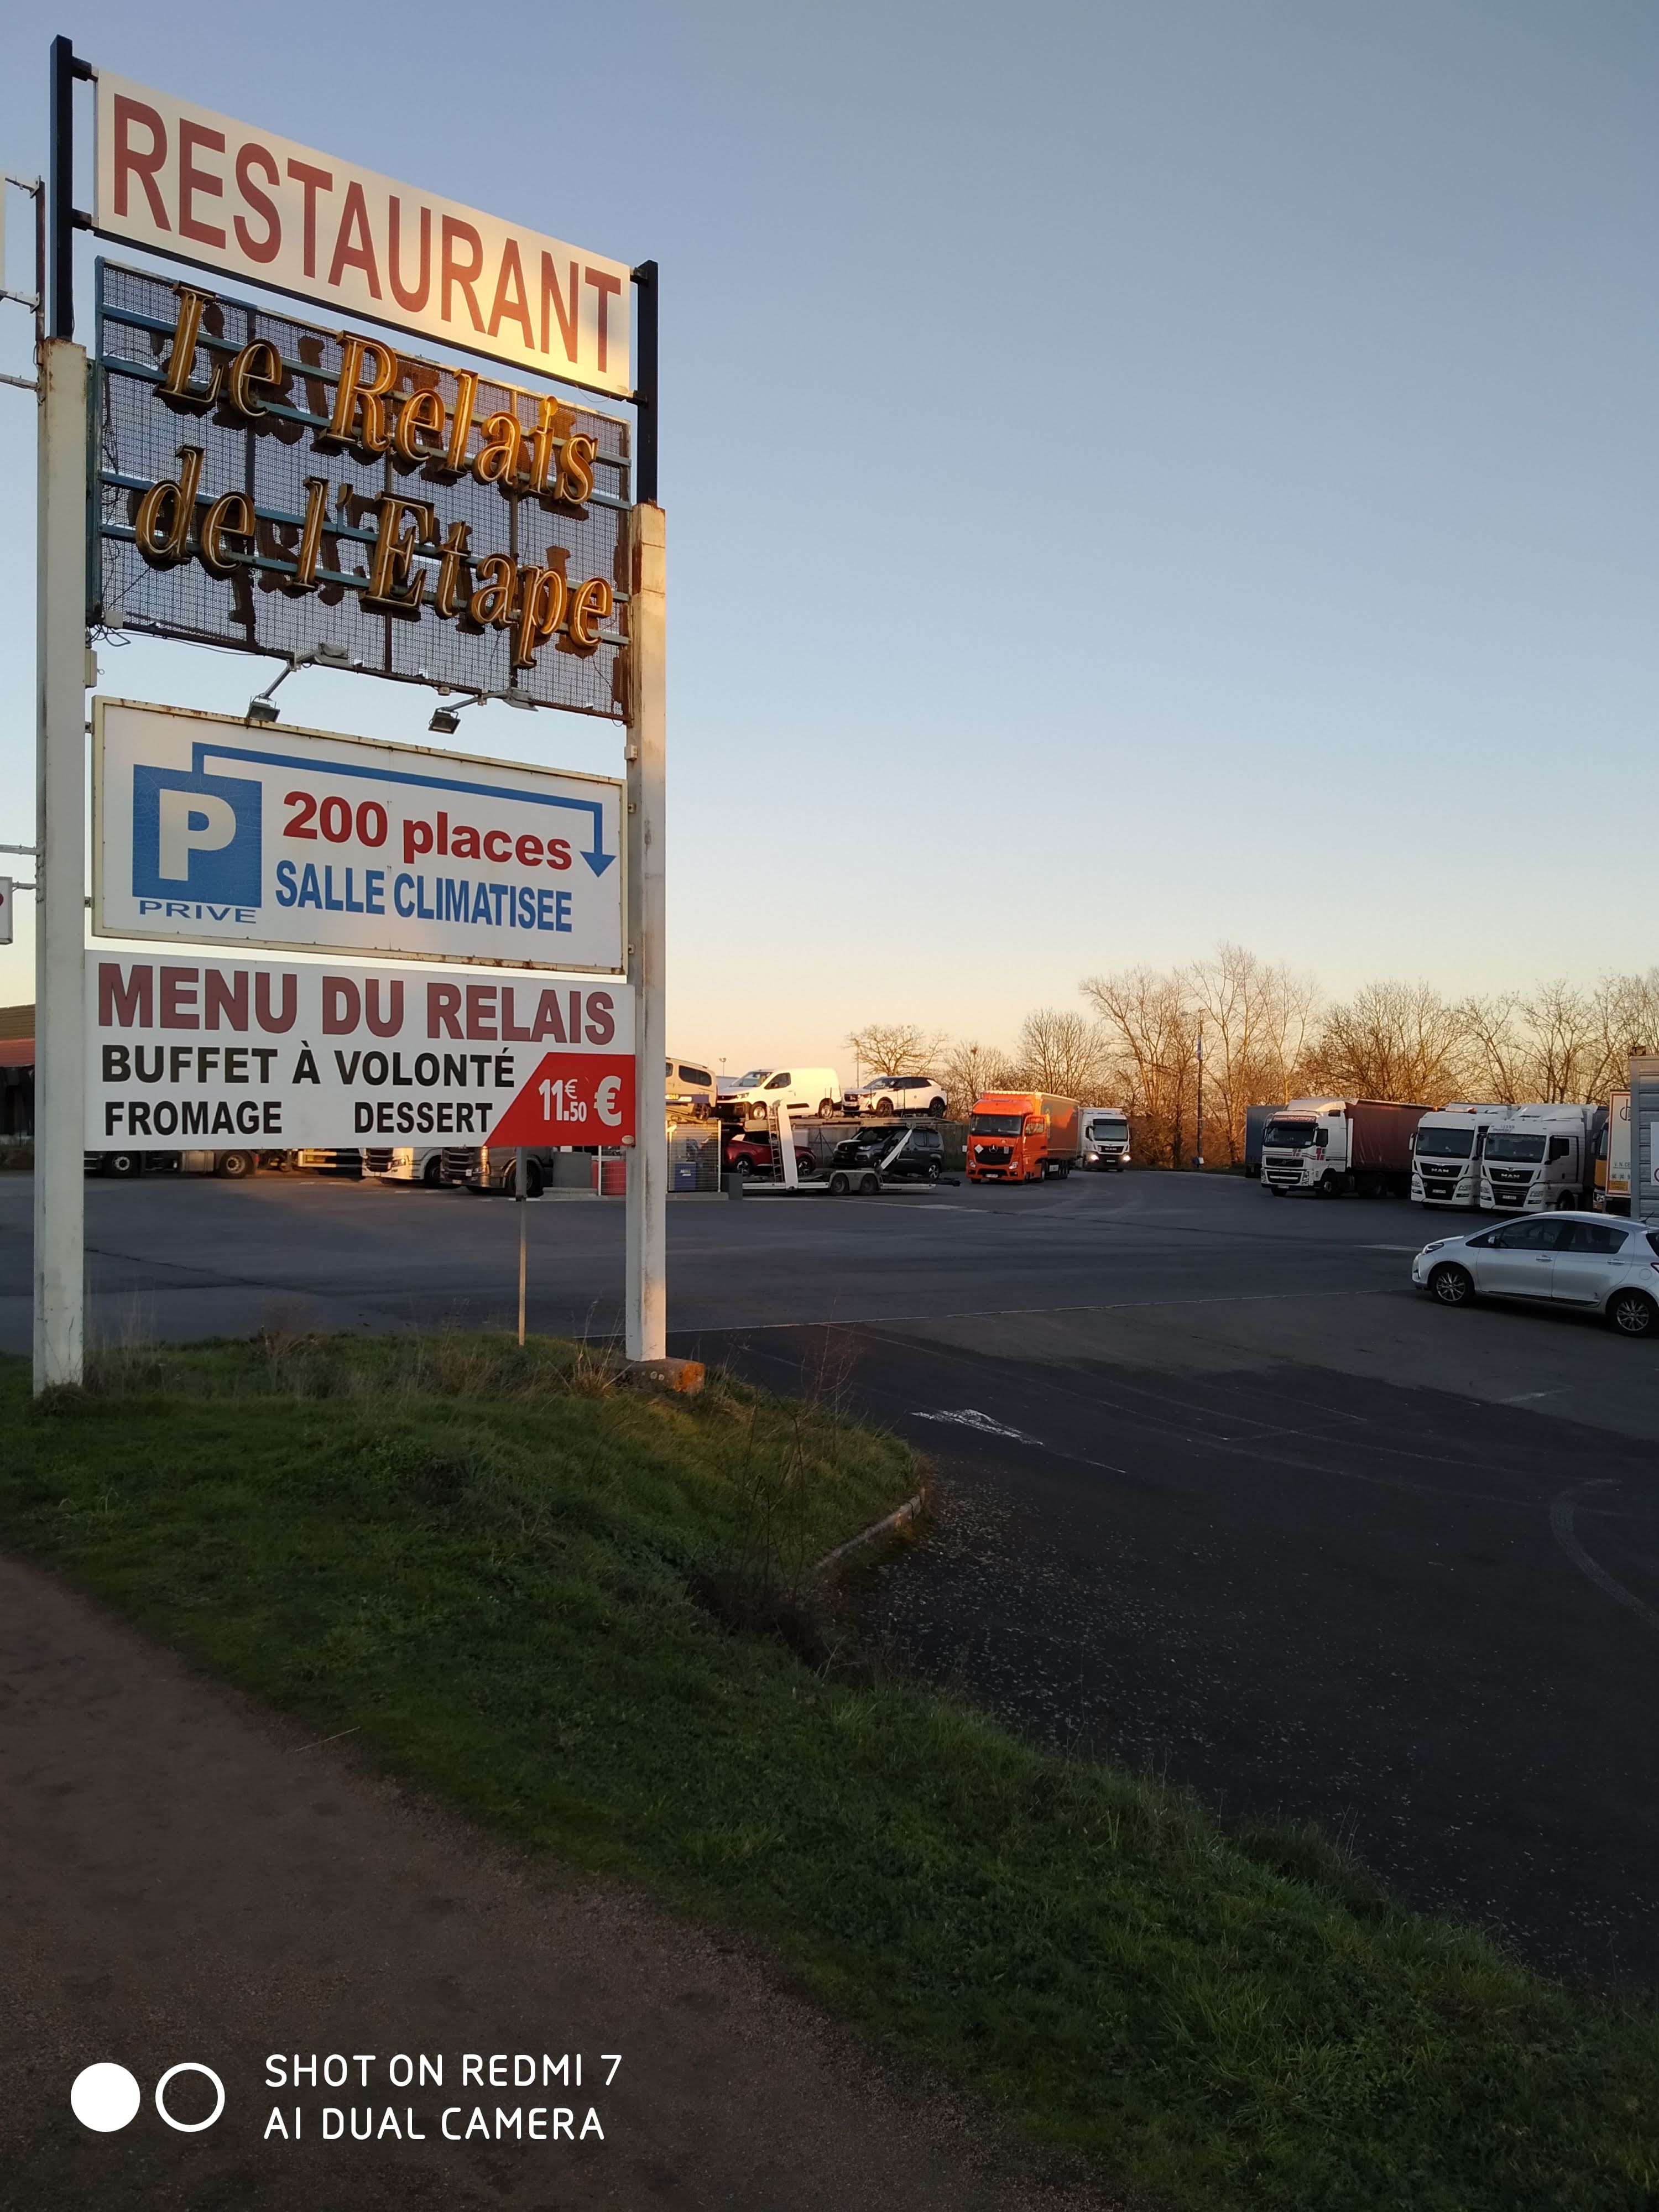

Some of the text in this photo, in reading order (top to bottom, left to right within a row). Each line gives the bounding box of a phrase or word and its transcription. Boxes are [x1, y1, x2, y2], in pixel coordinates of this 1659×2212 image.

[114, 93, 622, 372] RESTAURANT
[154, 281, 599, 505] Le Relais
[136, 445, 614, 669] de l'Etape
[159, 789, 237, 881] P
[283, 791, 573, 870] 200 places
[139, 900, 257, 924] PRIVE
[275, 859, 572, 933] SALLE CLIMATISEE
[97, 963, 615, 1045] MENU DU RELAIS
[102, 1040, 515, 1088] BUFFET À VOLONTÉ
[105, 1100, 493, 1136] FROMAGE DESSERT
